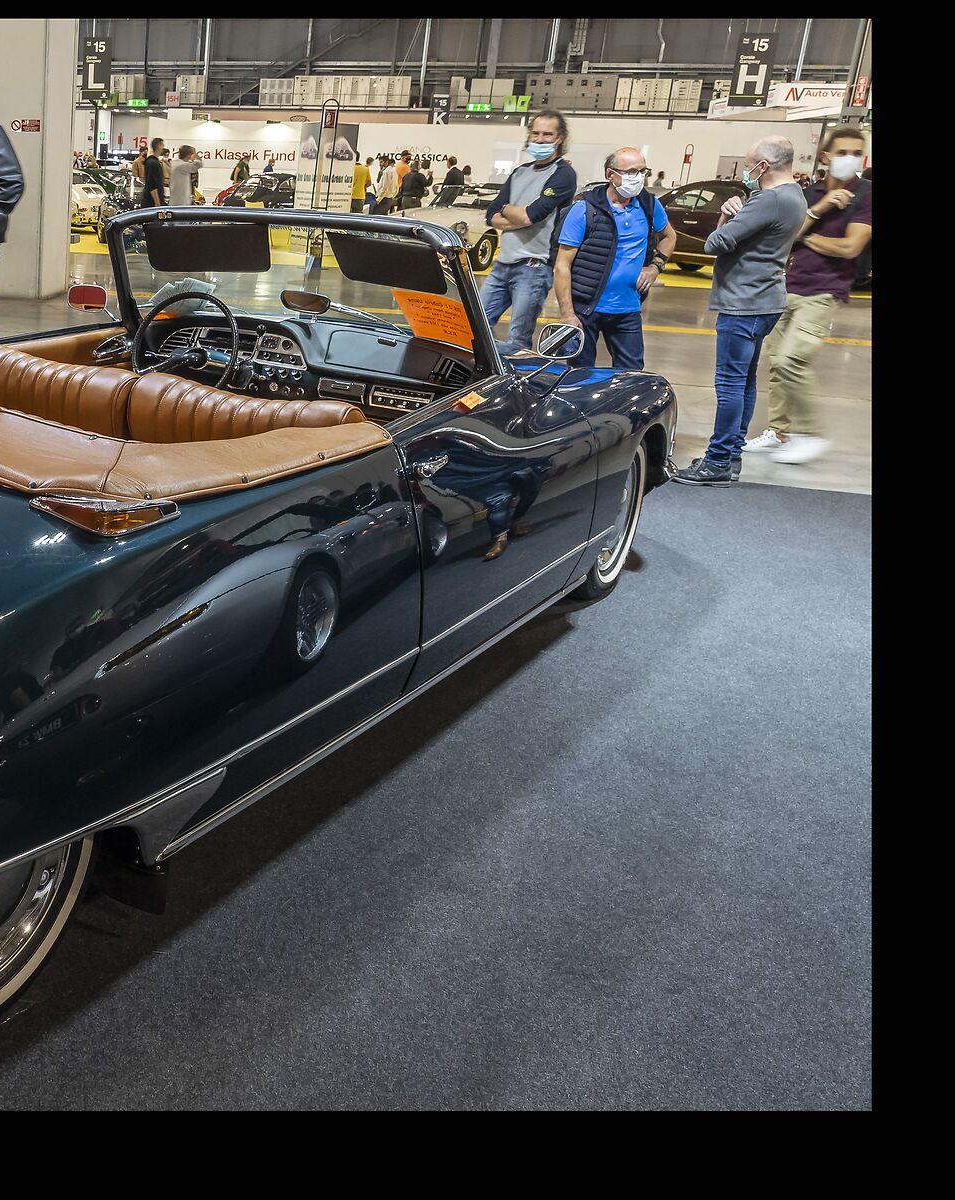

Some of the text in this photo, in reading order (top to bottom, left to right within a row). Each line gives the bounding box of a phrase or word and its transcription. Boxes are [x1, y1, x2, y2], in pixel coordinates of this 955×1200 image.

[93, 41, 106, 53] 15
[752, 38, 769, 52] 15
[88, 63, 105, 89] L
[736, 64, 768, 95] H
[805, 89, 828, 98] Auto
[433, 112, 447, 125] K
[133, 136, 148, 148] 15
[215, 148, 259, 161] Klassik
[263, 149, 296, 161] Fund
